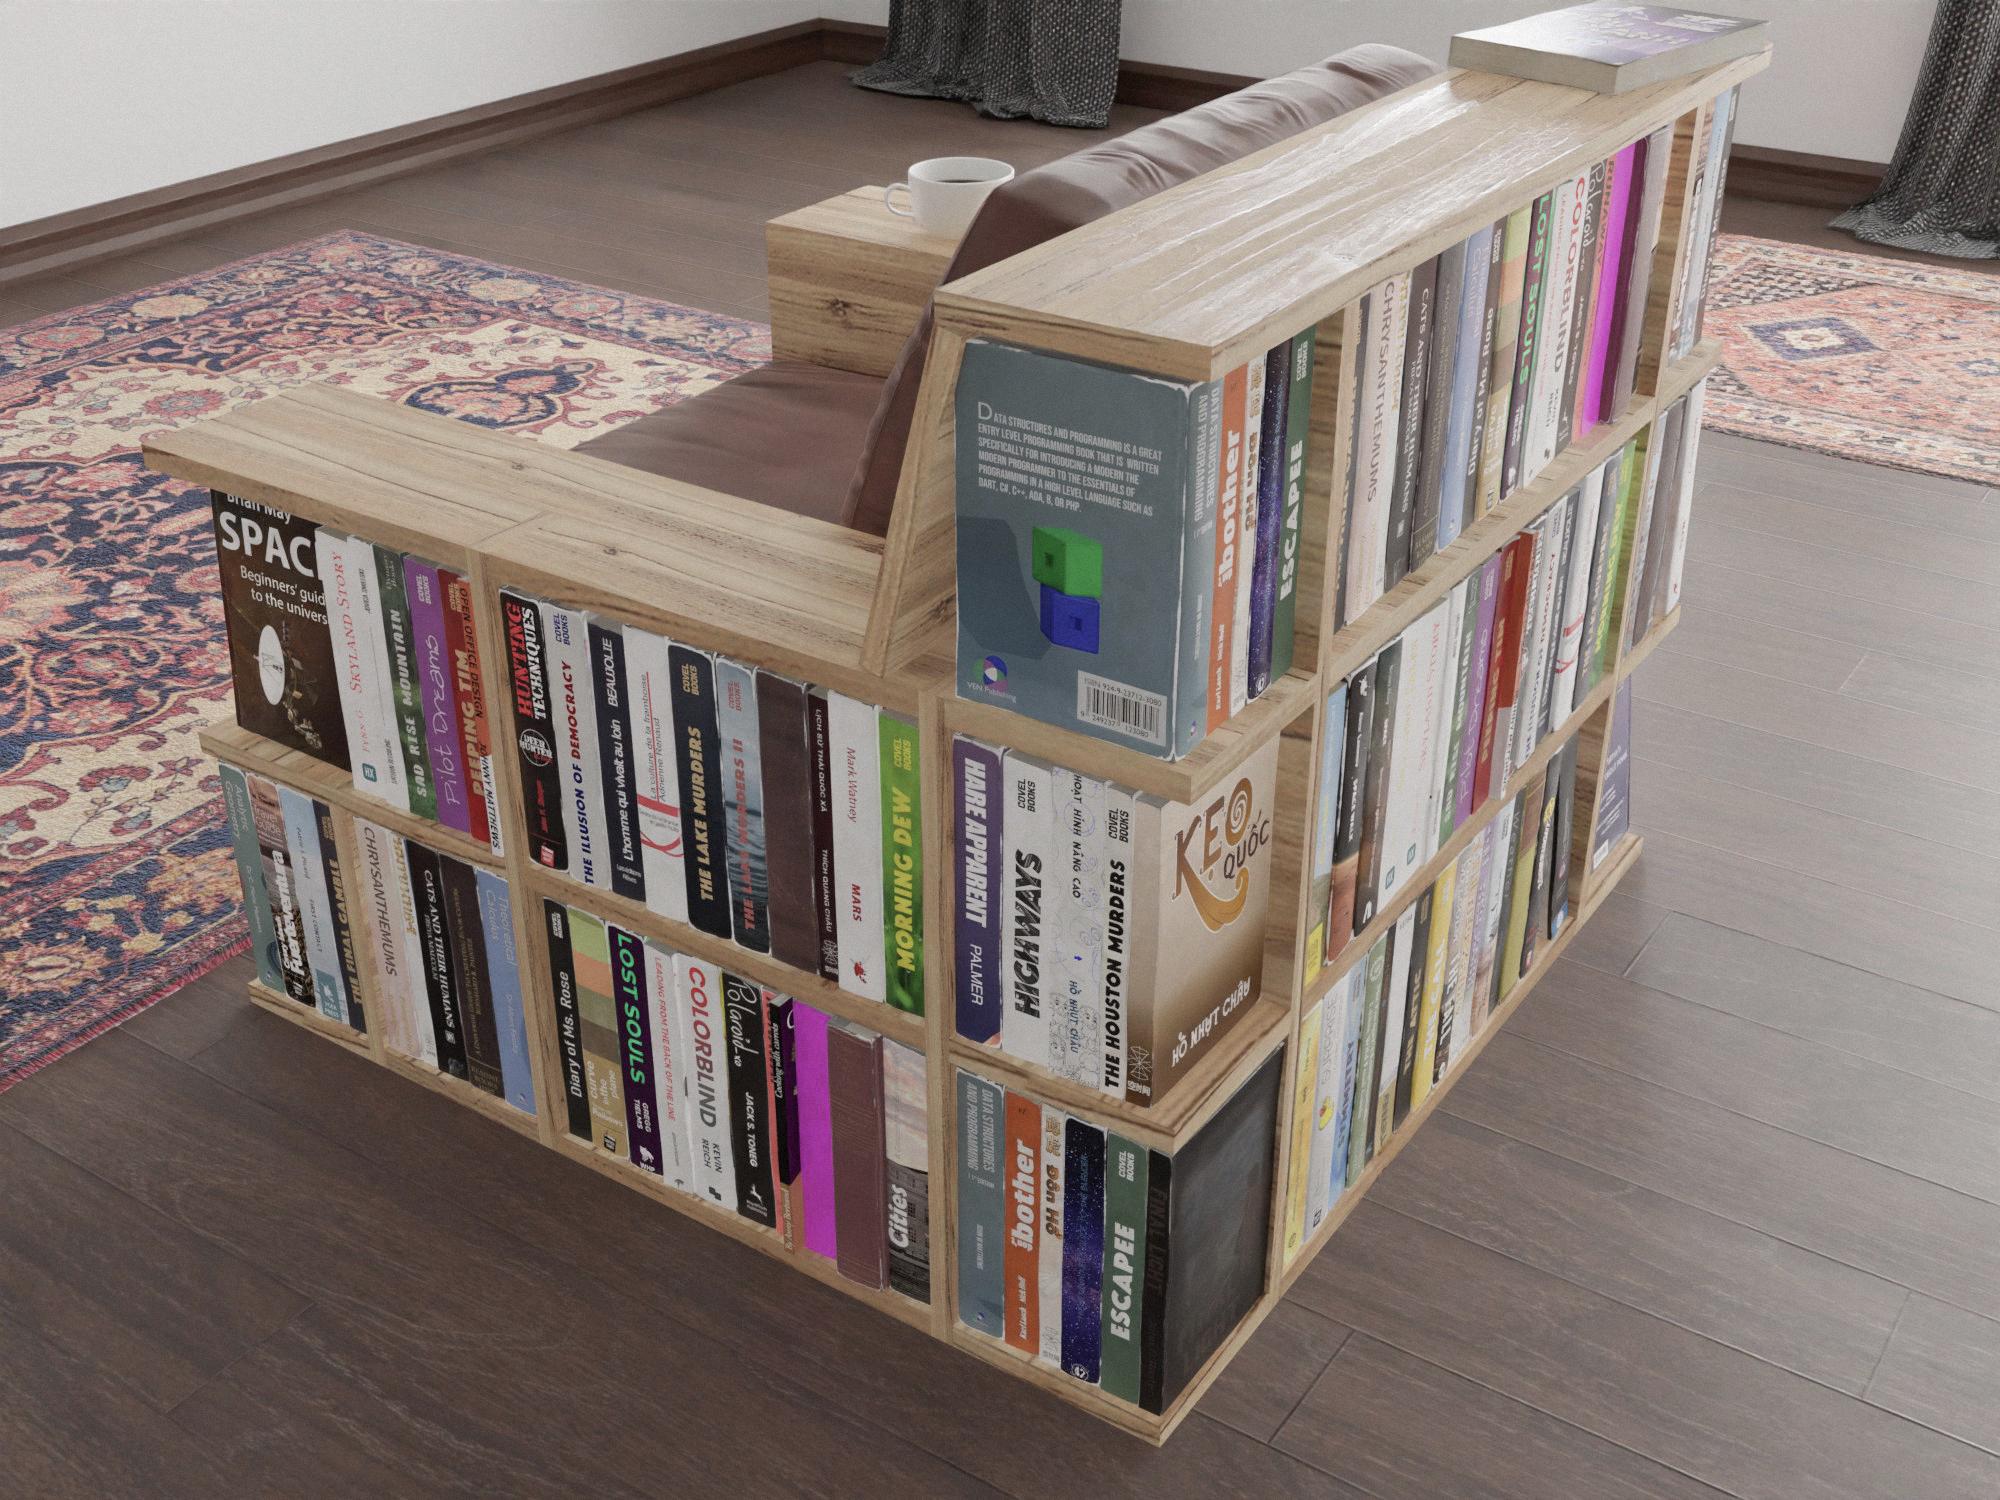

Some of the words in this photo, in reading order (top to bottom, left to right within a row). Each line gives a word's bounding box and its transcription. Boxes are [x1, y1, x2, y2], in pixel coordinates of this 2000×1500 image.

[1532, 194, 1550, 273] LOST
[1554, 176, 1585, 374] COLORBLIND
[1419, 287, 1430, 334] CATS
[1520, 286, 1540, 386] SOULS
[1414, 339, 1425, 379] AND
[1368, 281, 1395, 503] CHRYSANTHEMUMS
[978, 423, 1000, 437] ENTRY
[1001, 429, 1022, 442] LEVEL
[1023, 434, 1074, 455] PROGRAMMING
[1097, 451, 1115, 464] THAT
[1127, 458, 1159, 476] WRITTEN
[1008, 416, 1052, 436] STRUCTURES
[1054, 427, 1068, 440] AND
[1070, 431, 1122, 452] PROGRAMMING
[1139, 447, 1162, 461] GREAT
[1468, 425, 1482, 477] Diary
[1476, 398, 1487, 421] of
[1026, 448, 1038, 460] FOR
[1125, 472, 1140, 485] THE
[1069, 473, 1081, 484] THE
[1402, 437, 1418, 513] HUMANS
[1280, 440, 1303, 600] ESCAPEE
[220, 511, 317, 578] SPAC
[250, 588, 263, 602] to
[265, 592, 284, 610] the
[286, 602, 328, 625] univers
[300, 588, 327, 606] guid
[460, 588, 470, 622] OPEN
[552, 613, 562, 642] COVEL
[562, 615, 571, 646] BOOKS
[390, 609, 414, 706] MOUNTAIN
[464, 626, 474, 669] OFFICE
[505, 602, 534, 719] HUNTING
[521, 607, 547, 720] TECHNIQUES
[425, 635, 449, 734] Dreams
[455, 649, 472, 693] TIM
[682, 663, 690, 693] COVEL
[690, 665, 699, 695] BOOKS
[470, 673, 483, 717] DESIGN
[561, 659, 581, 760] DEMOCRACY
[404, 715, 421, 756] RISE
[461, 702, 484, 797] PEEPING
[611, 719, 623, 741] loin
[733, 738, 743, 753] II
[614, 742, 624, 758] au
[847, 746, 857, 777] Mark
[893, 738, 902, 768] COVEL
[903, 740, 912, 771] BOOKS
[413, 765, 427, 797] SAD
[437, 744, 460, 805] Pilot
[572, 764, 583, 784] OF
[614, 757, 626, 788] vivait
[688, 726, 707, 816] MURDERS
[965, 757, 987, 819] HARE
[616, 790, 629, 809] qui
[847, 779, 857, 823] Watney
[1018, 779, 1026, 809] COVEL
[1027, 781, 1036, 812] BOOKS
[487, 791, 501, 848] MATTHEWS
[575, 789, 592, 854] ILLUSION
[620, 810, 634, 862] L'homme
[892, 787, 913, 847] DEW
[1108, 808, 1118, 839] COVEL
[1119, 810, 1129, 843] BOOKS
[694, 819, 710, 866] LAKE
[423, 869, 436, 903] CATS
[583, 859, 595, 884] THE
[699, 869, 714, 900] THE
[965, 818, 988, 928] APPARENT
[1072, 878, 1082, 899] CAO
[364, 827, 398, 977] CHRYSANTHEMUMS
[430, 903, 441, 933] AND
[743, 898, 756, 929] THE
[852, 884, 862, 922] MARS
[893, 853, 915, 972] MORNING
[1107, 860, 1126, 954] MURDERS
[552, 912, 560, 937] COVEL
[1014, 849, 1042, 1019] HIGHWAYS
[436, 934, 447, 976] THEIR
[617, 933, 640, 1001] LOST
[560, 971, 572, 1009] Rose
[655, 957, 666, 999] LEADING
[970, 944, 984, 1006] PALMER
[439, 975, 456, 1029] HUMANS
[657, 999, 668, 1027] FROM
[1105, 958, 1122, 1051] HOUSTON
[563, 1013, 575, 1040] Ms.
[624, 1003, 646, 1085] SOULS
[660, 1028, 670, 1044] THE
[567, 1037, 577, 1056] of
[662, 1045, 673, 1068] BACK
[689, 967, 717, 1128] COLORBLIND
[566, 1057, 583, 1098] Diary
[665, 1068, 674, 1081] OF
[665, 1081, 675, 1099] THE
[1105, 1054, 1120, 1088] THE
[666, 1100, 676, 1121] LINE
[745, 1091, 755, 1121] JACK
[966, 1082, 977, 1103] AND
[982, 1088, 993, 1114] DATA
[642, 1102, 652, 1133] GREGG
[967, 1104, 979, 1170] PROGRAMMING
[701, 1138, 711, 1169] REICH
[712, 1143, 723, 1173] KEVIN
[982, 1115, 995, 1173] STRUCTURES
[1118, 1151, 1126, 1178] COVEL
[1126, 1152, 1135, 1181] BOOKS
[888, 1184, 909, 1248] Cities
[1110, 1221, 1135, 1341] ESCAPEE
